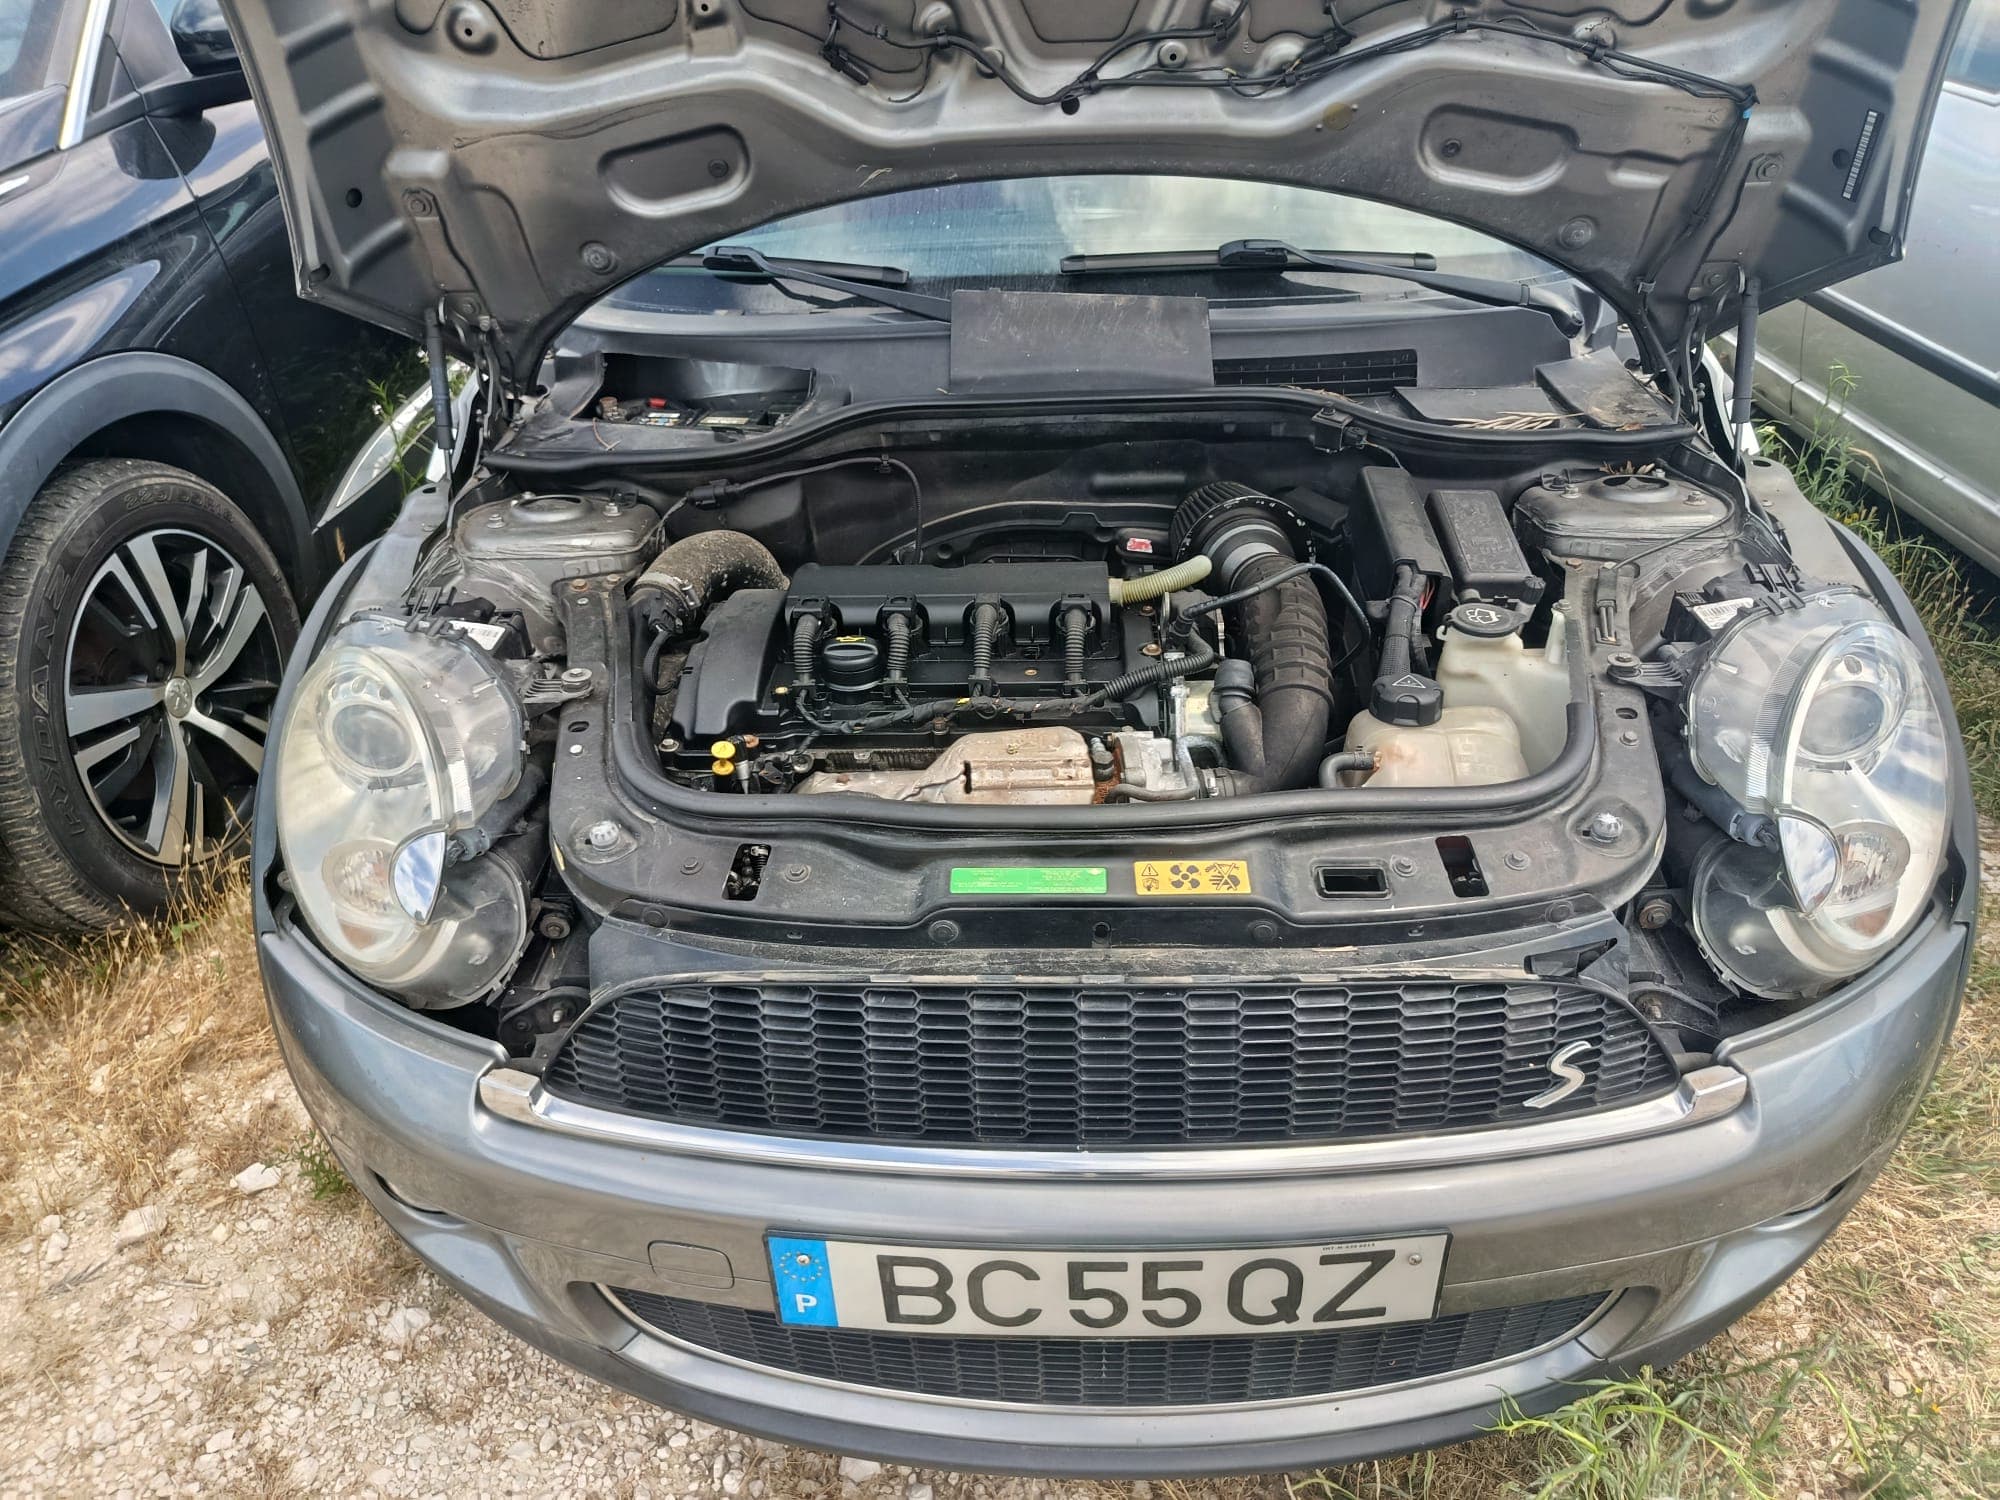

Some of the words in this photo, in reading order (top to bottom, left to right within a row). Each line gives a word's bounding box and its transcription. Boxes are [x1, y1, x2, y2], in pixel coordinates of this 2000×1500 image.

[31, 563, 86, 836] RYDANZ
[1522, 1040, 1592, 1109] S
[794, 1293, 818, 1313] P
[876, 1254, 1042, 1327] BC
[1067, 1260, 1203, 1329] 55
[1227, 1249, 1396, 1326] QZ
